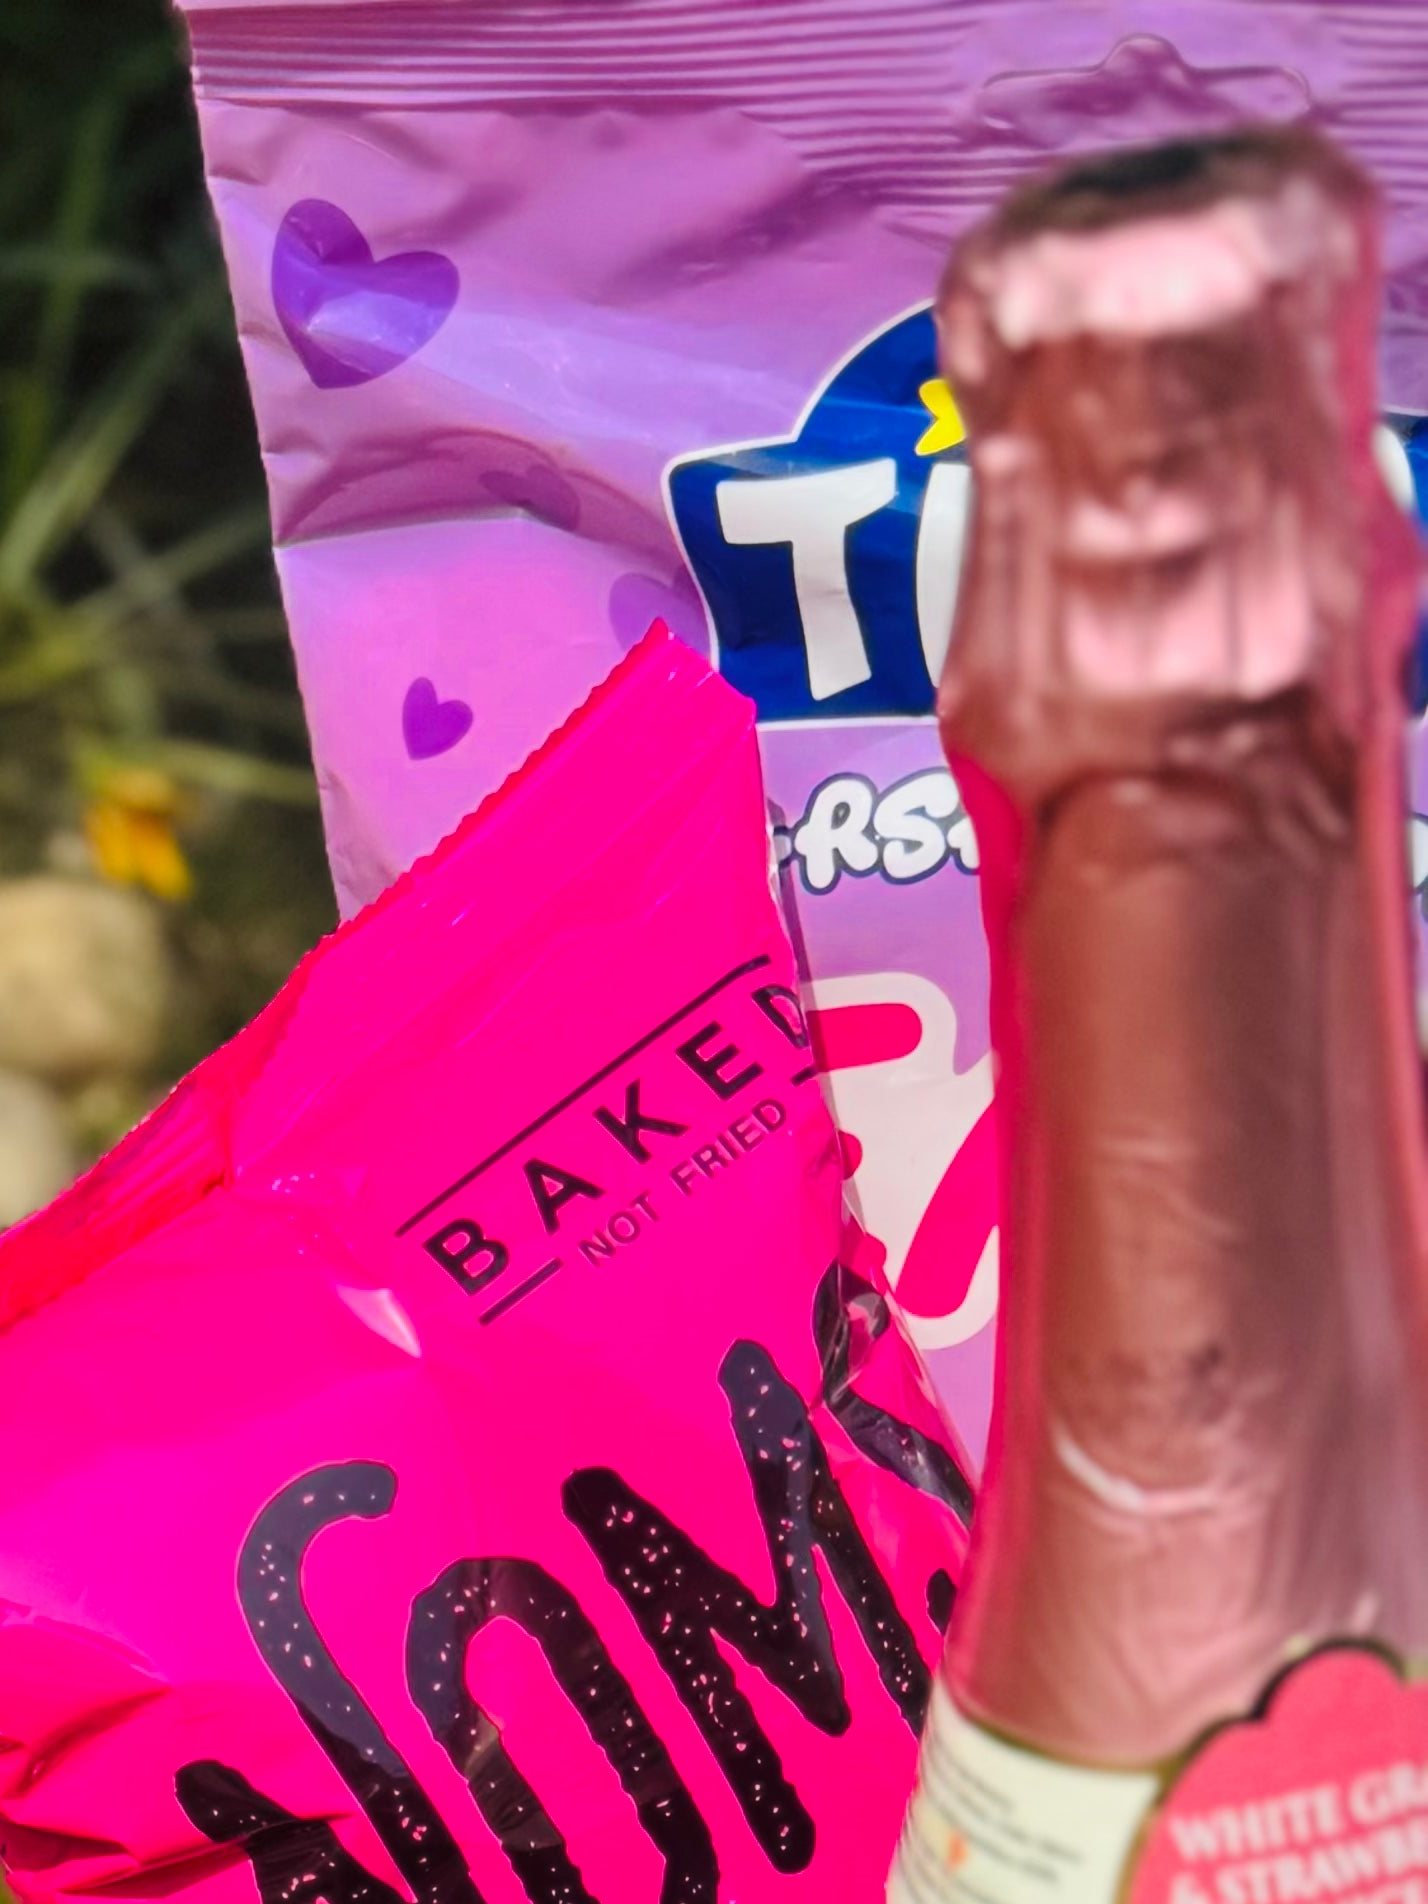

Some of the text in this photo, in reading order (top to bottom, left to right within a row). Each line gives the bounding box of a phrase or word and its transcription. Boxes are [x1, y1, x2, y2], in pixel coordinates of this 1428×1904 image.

[578, 1099, 787, 1268] NOT FRIED
[1168, 1784, 1342, 1863] WHITE
